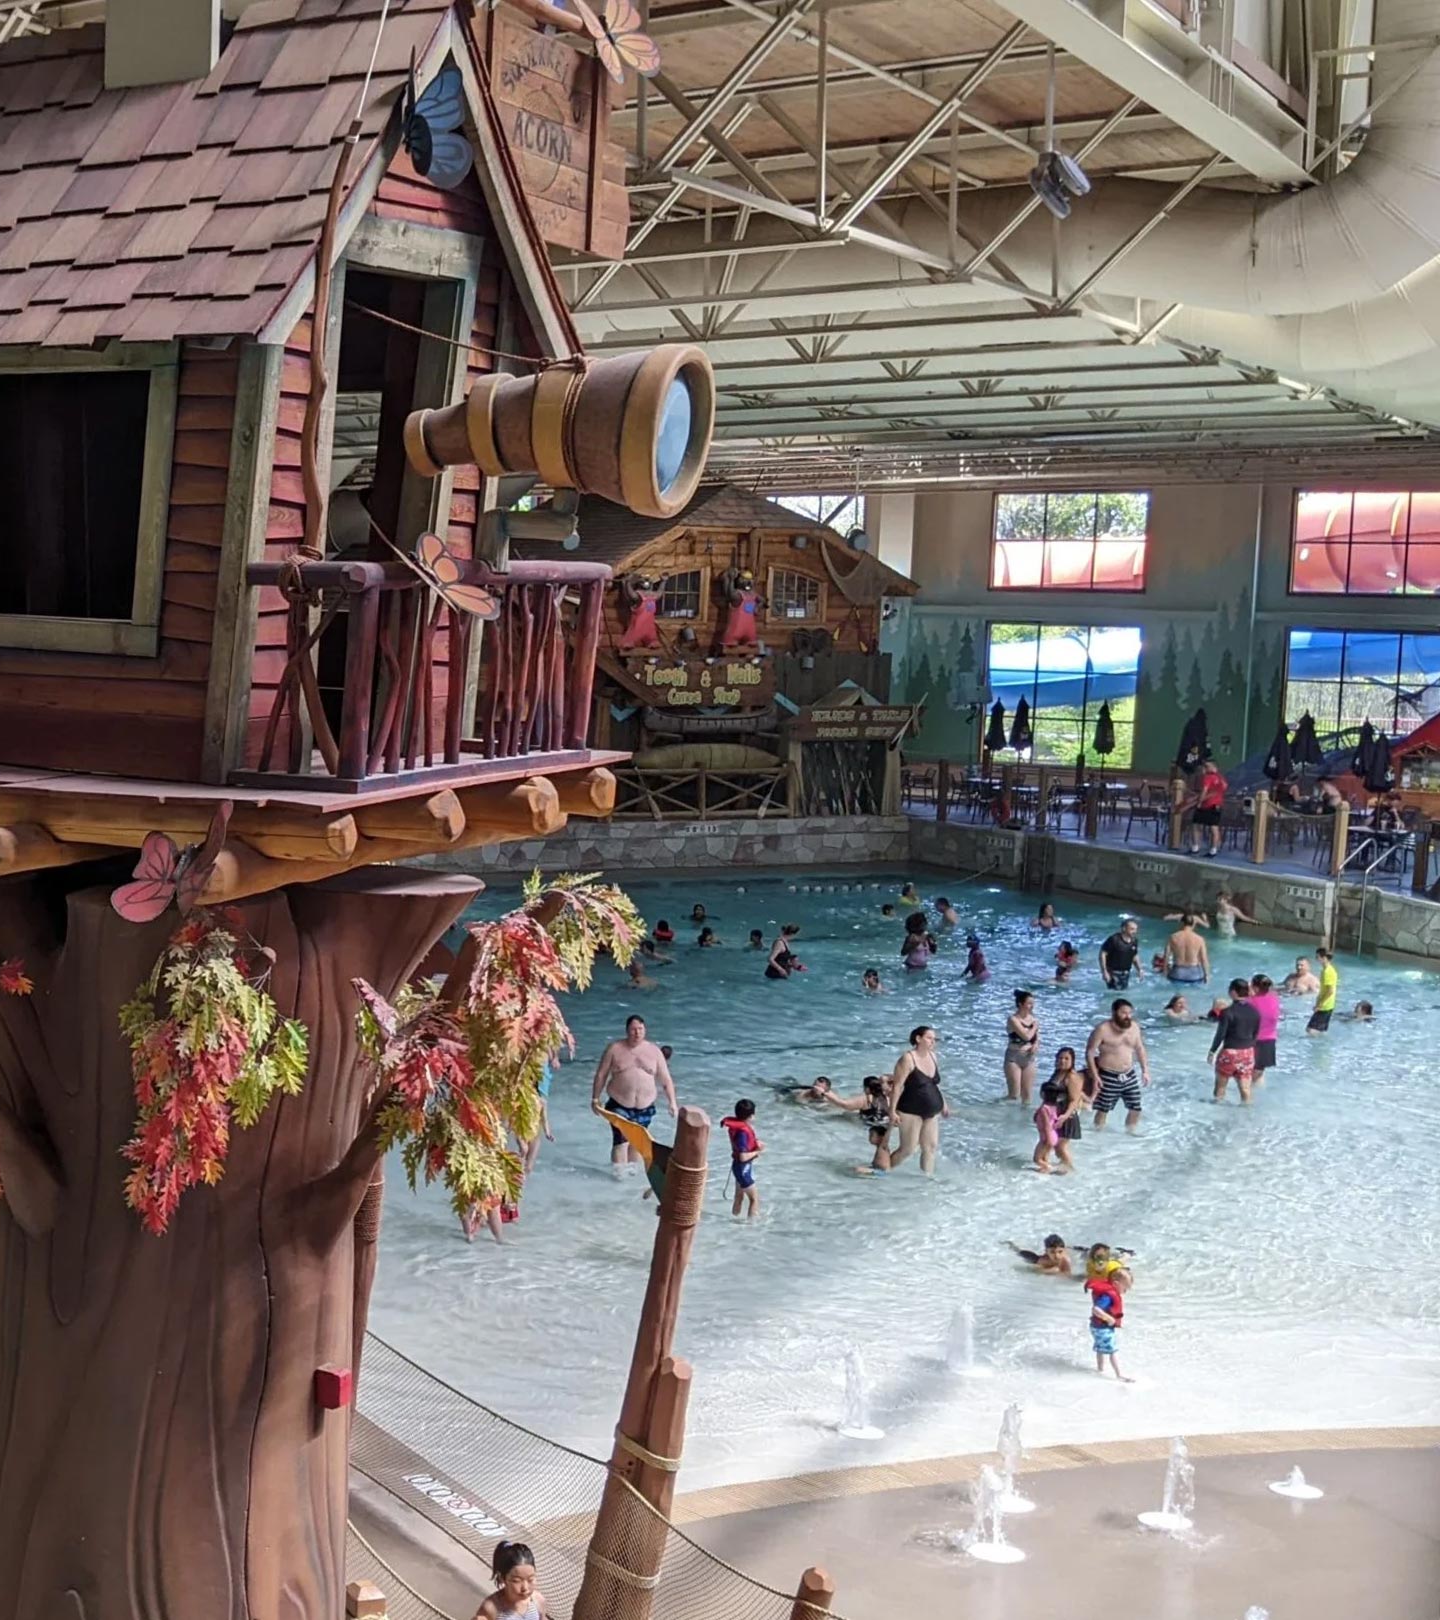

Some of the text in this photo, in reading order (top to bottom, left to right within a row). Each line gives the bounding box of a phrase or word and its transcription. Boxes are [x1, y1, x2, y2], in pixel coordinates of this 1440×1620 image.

[512, 110, 573, 163] ACORN
[644, 664, 688, 686] Tooth
[727, 663, 761, 685] Nails
